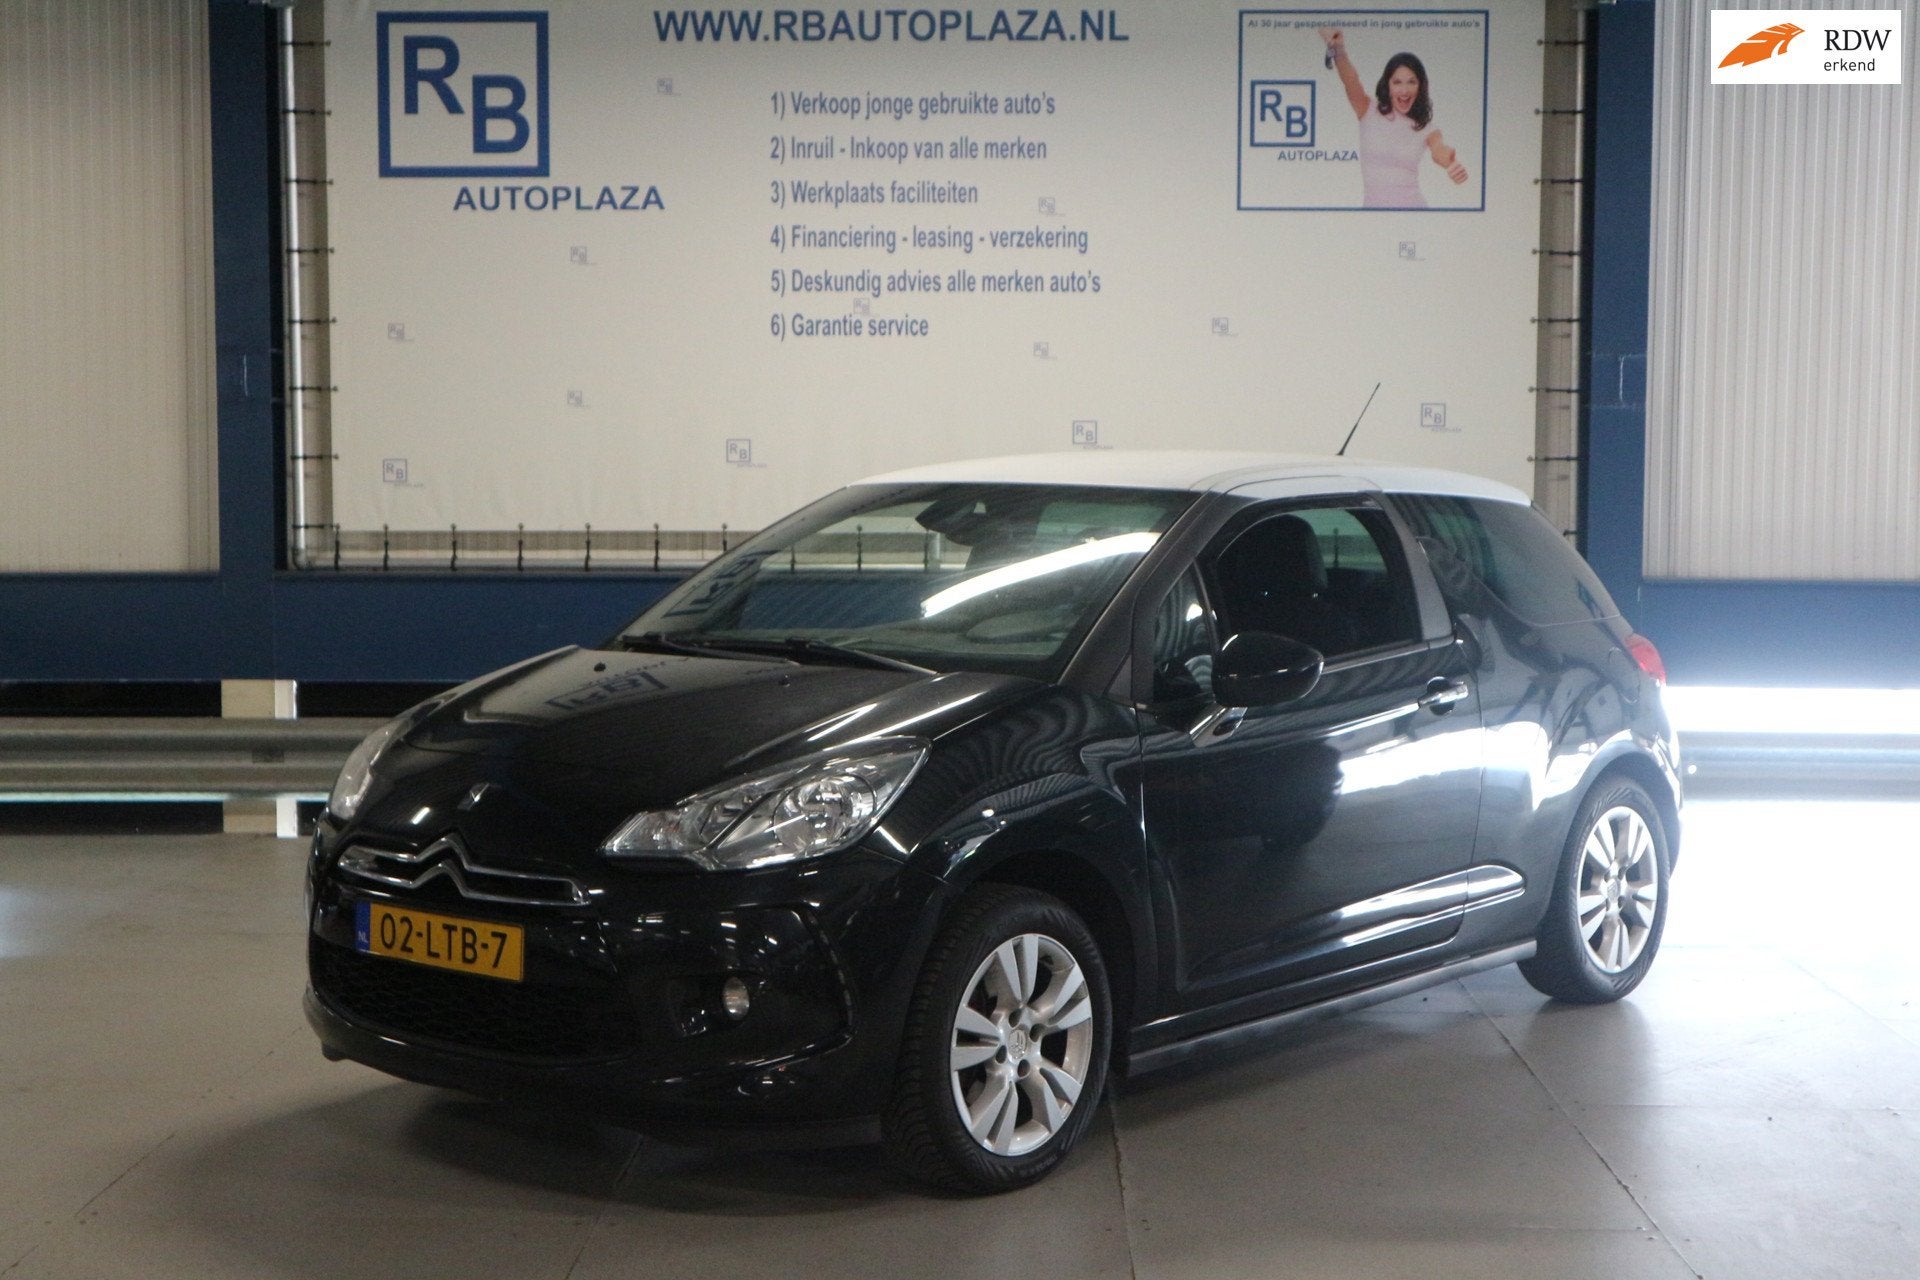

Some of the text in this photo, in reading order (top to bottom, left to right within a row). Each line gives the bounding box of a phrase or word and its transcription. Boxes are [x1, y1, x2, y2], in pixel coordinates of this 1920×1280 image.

[654, 9, 1129, 42] WWW.RBAUTOPLAZA.NL
[771, 92, 1055, 120] 1) Verkoop jonge gebruikte auto's
[770, 136, 785, 164] 2)
[791, 136, 834, 159] Inruil
[850, 136, 908, 164] Inkoop
[914, 142, 943, 159] van
[949, 136, 978, 159] alle
[984, 136, 1046, 159] merken
[1278, 150, 1358, 161] AUTOPLAZA
[453, 186, 665, 211] AUTOPLAZA
[771, 180, 978, 208] 3) Werkplaats faciliteiten
[770, 225, 785, 253] 4)
[791, 225, 896, 254] Financiering
[913, 225, 973, 254] leasing
[990, 225, 1088, 254] verzekering
[770, 269, 1101, 298] 5) Deskundig advies alle merken auto's
[770, 314, 929, 342] 6) Garantie service
[381, 912, 508, 969] 02-LTB-7
